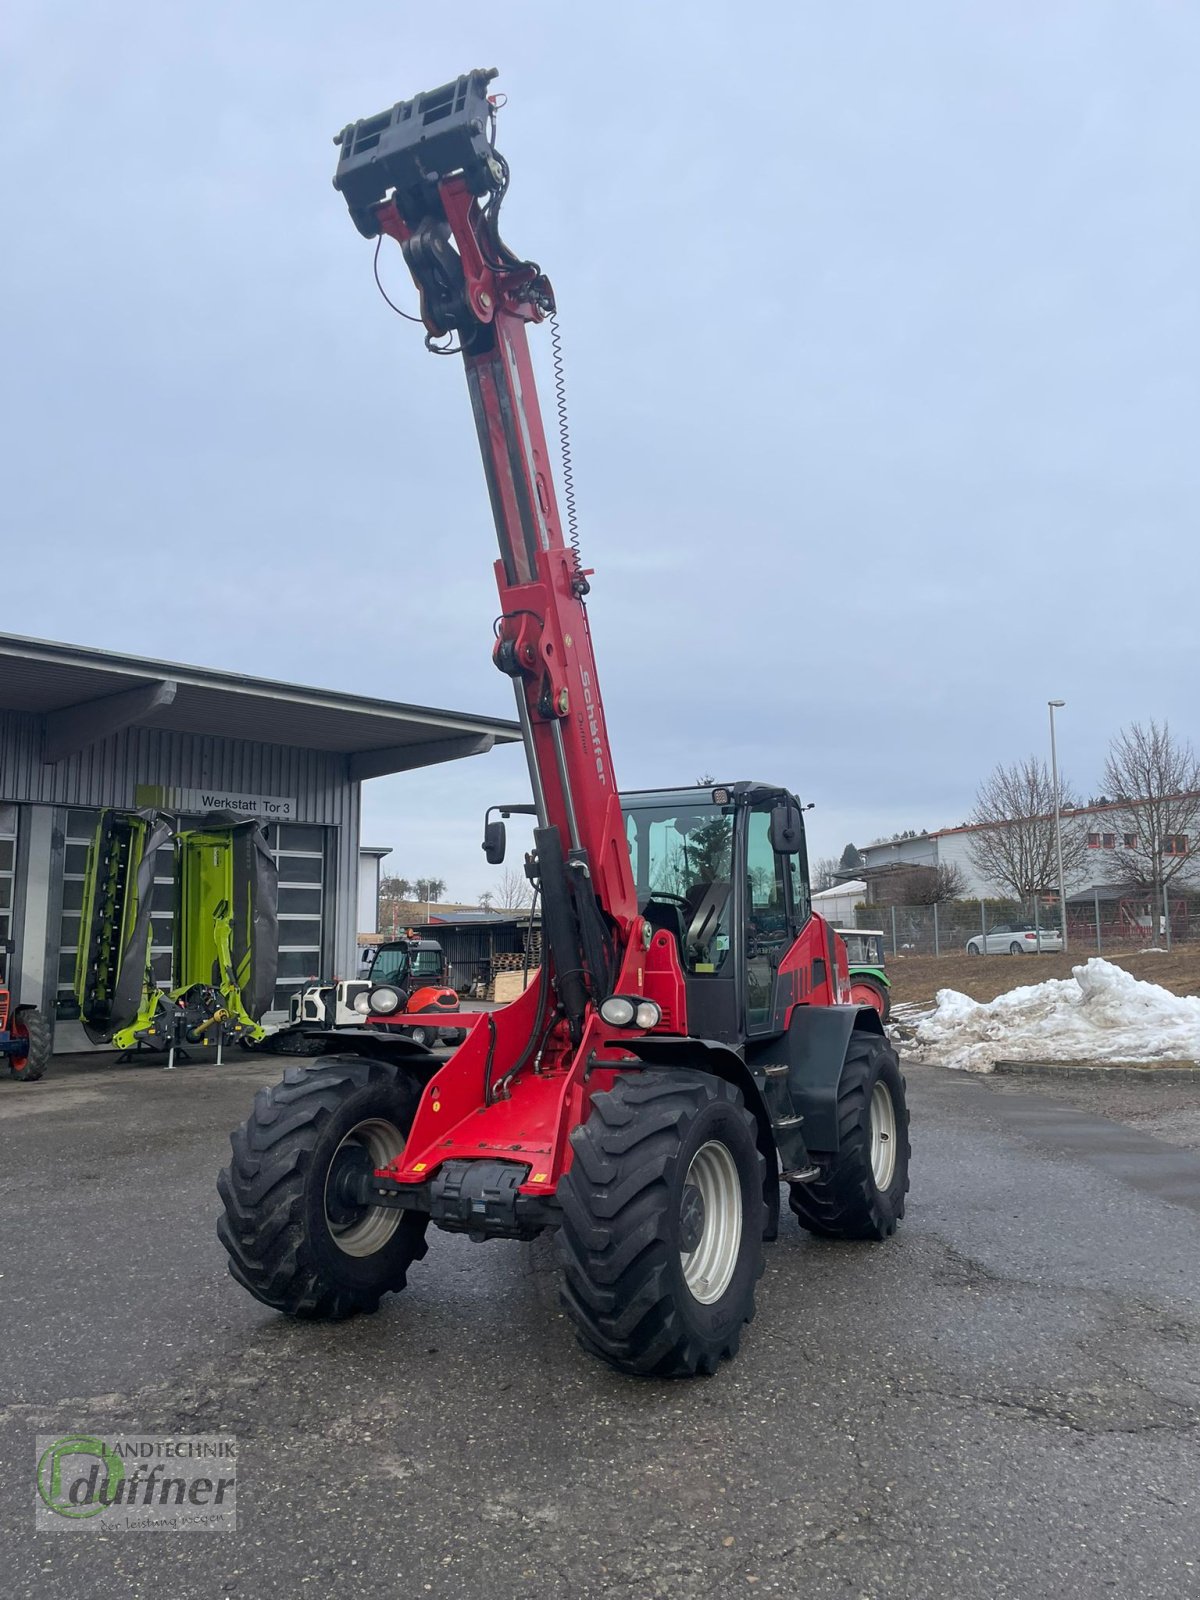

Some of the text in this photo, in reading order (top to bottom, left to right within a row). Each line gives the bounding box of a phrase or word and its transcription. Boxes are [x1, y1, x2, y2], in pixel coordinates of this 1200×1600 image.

[202, 795, 290, 814] Werkstatt Tor 3
